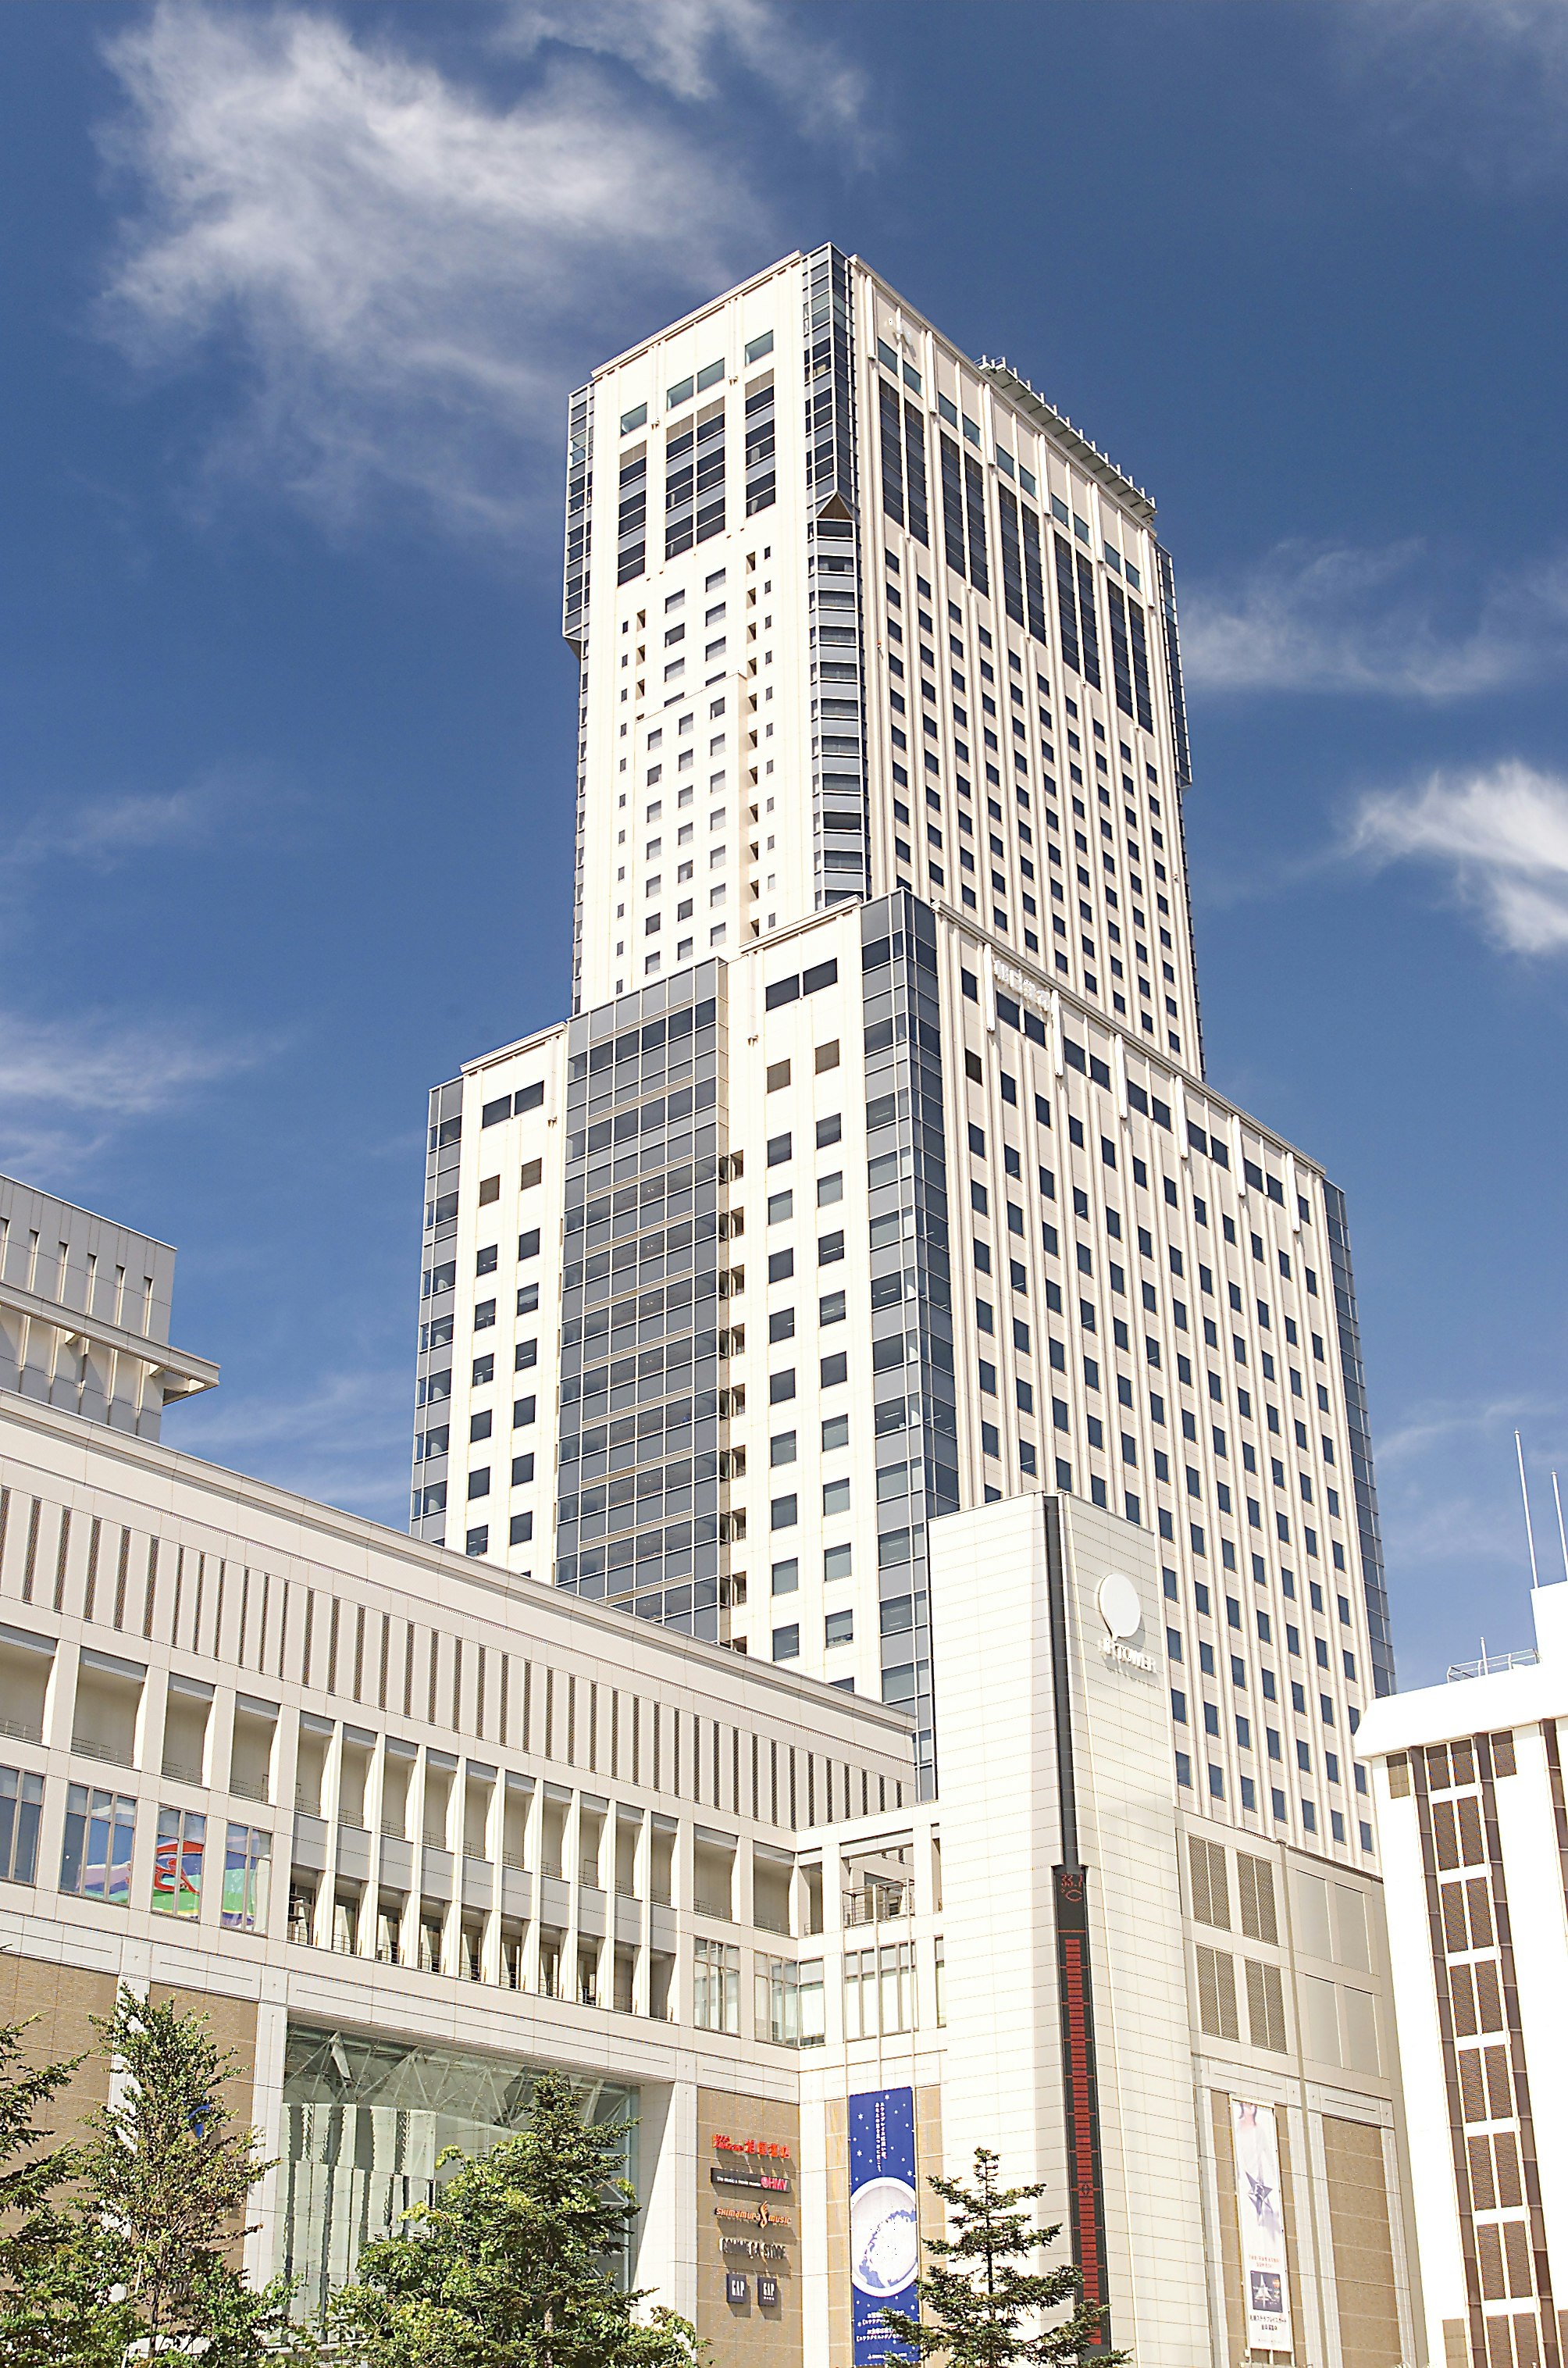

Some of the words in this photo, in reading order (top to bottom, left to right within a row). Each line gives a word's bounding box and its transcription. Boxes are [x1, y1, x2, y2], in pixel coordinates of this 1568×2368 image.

[769, 2177, 789, 2191] HMV
[732, 2280, 745, 2297] GAP
[763, 2282, 775, 2296] GAP
